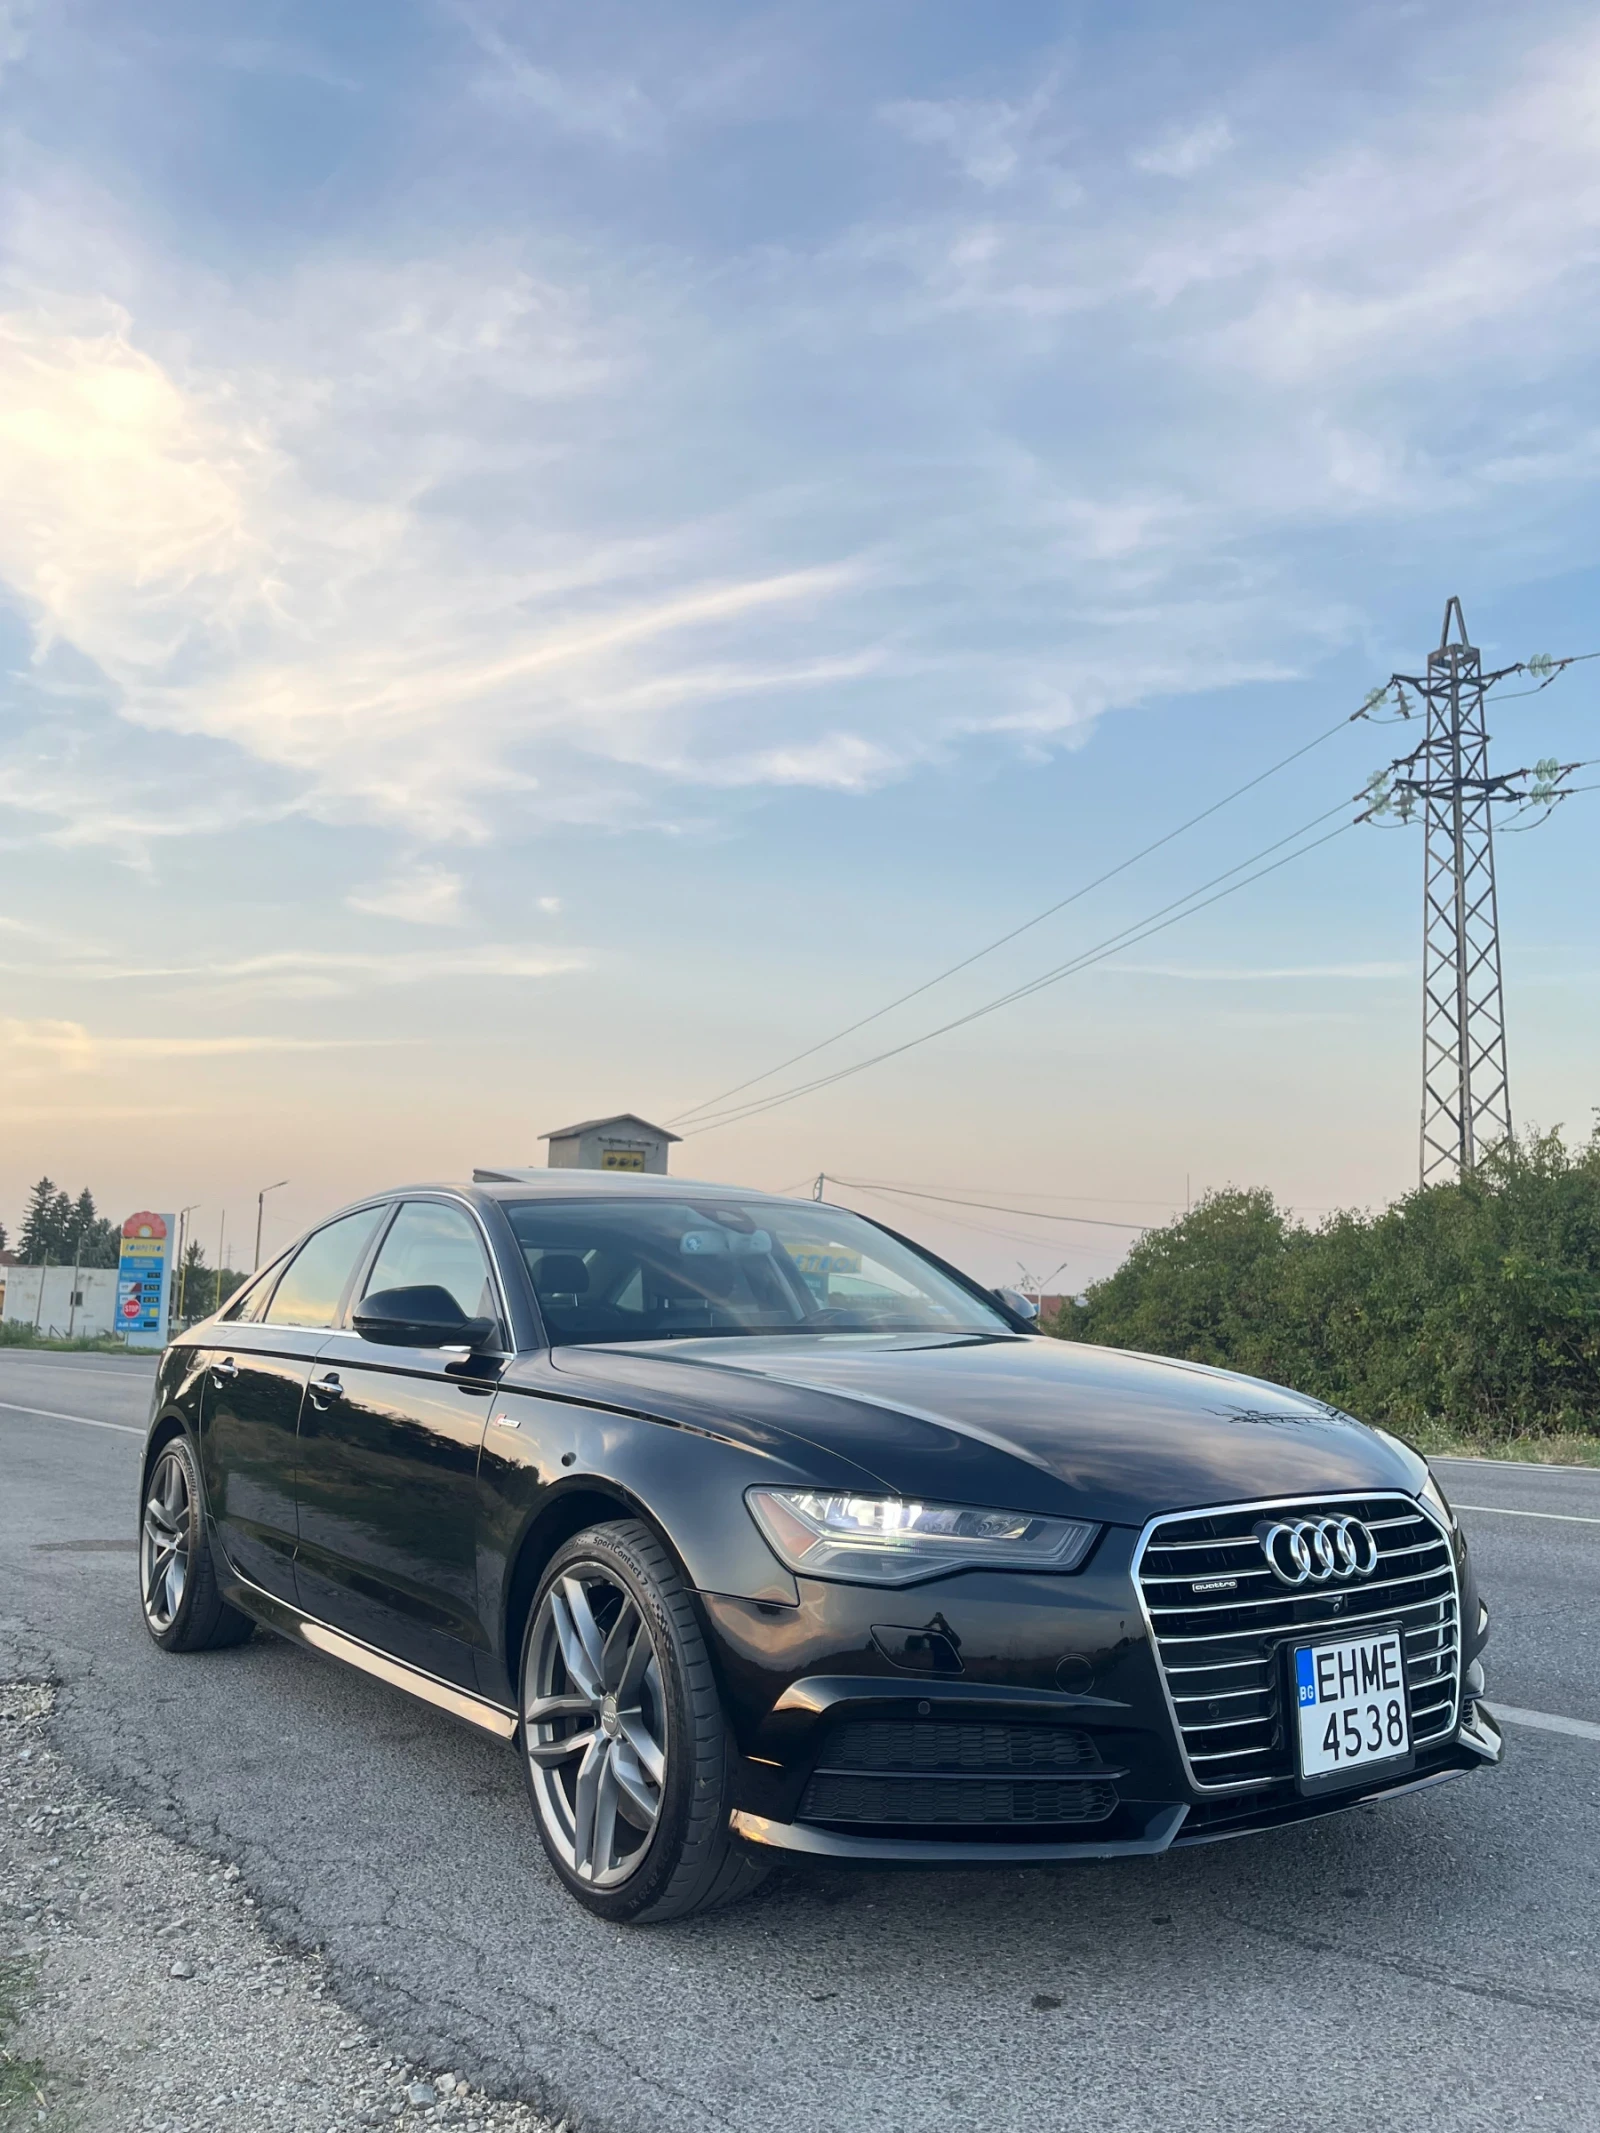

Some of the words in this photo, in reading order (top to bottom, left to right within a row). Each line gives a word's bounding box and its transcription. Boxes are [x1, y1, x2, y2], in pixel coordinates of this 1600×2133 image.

[124, 1304, 139, 1312] STOP
[593, 1536, 642, 1578] SportContact
[641, 1578, 649, 1586] 7
[1195, 1581, 1236, 1591] quattro
[1316, 1641, 1400, 1704] EHME
[1300, 1685, 1315, 1701] BG
[1322, 1699, 1404, 1761] 4538
